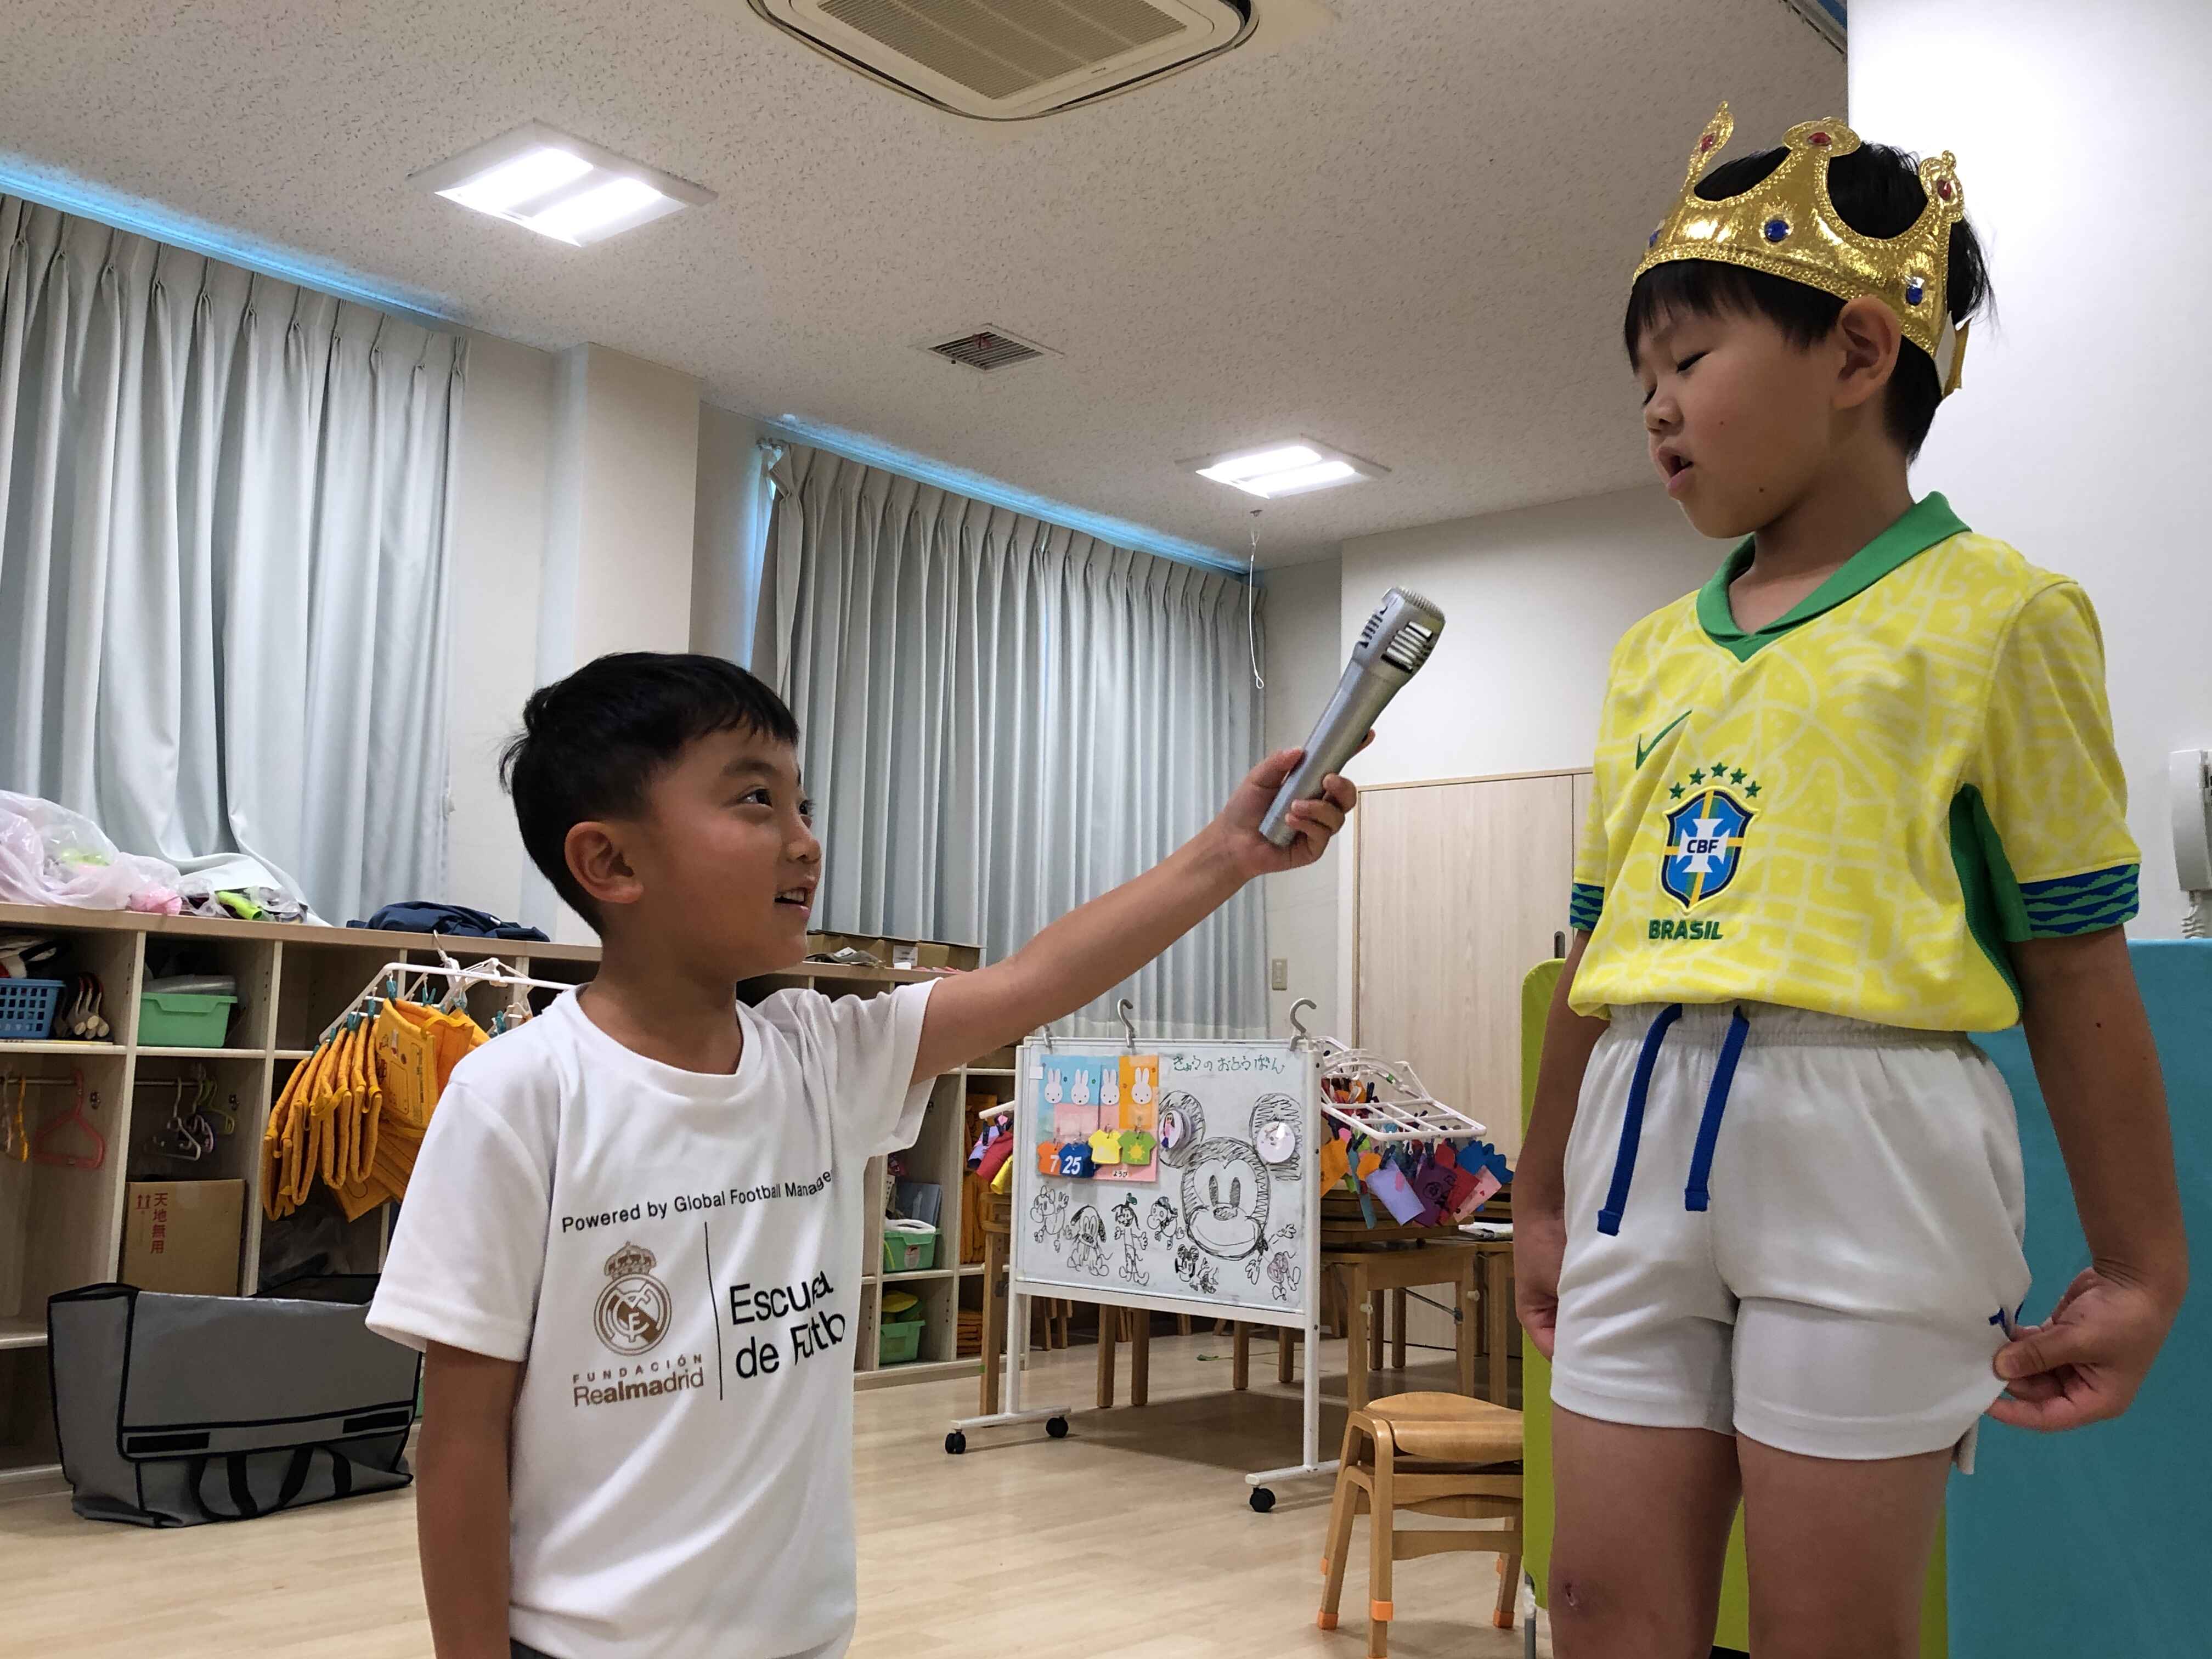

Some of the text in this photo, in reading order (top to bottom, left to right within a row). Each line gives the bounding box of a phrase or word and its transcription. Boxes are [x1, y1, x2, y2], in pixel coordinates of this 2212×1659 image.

[1687, 839, 1719, 854] CBF
[1648, 919, 1724, 940] BRASIL
[1050, 1155, 1082, 1175] 7 25
[150, 1192, 168, 1254] 天地無用
[562, 1204, 641, 1233] Powered
[647, 1201, 667, 1219] by
[674, 1190, 726, 1212] Global
[730, 1183, 781, 1205] Football
[573, 1354, 702, 1383] FUNDACIÓN
[736, 1336, 780, 1379] de
[573, 1367, 704, 1407] Realmadrid
